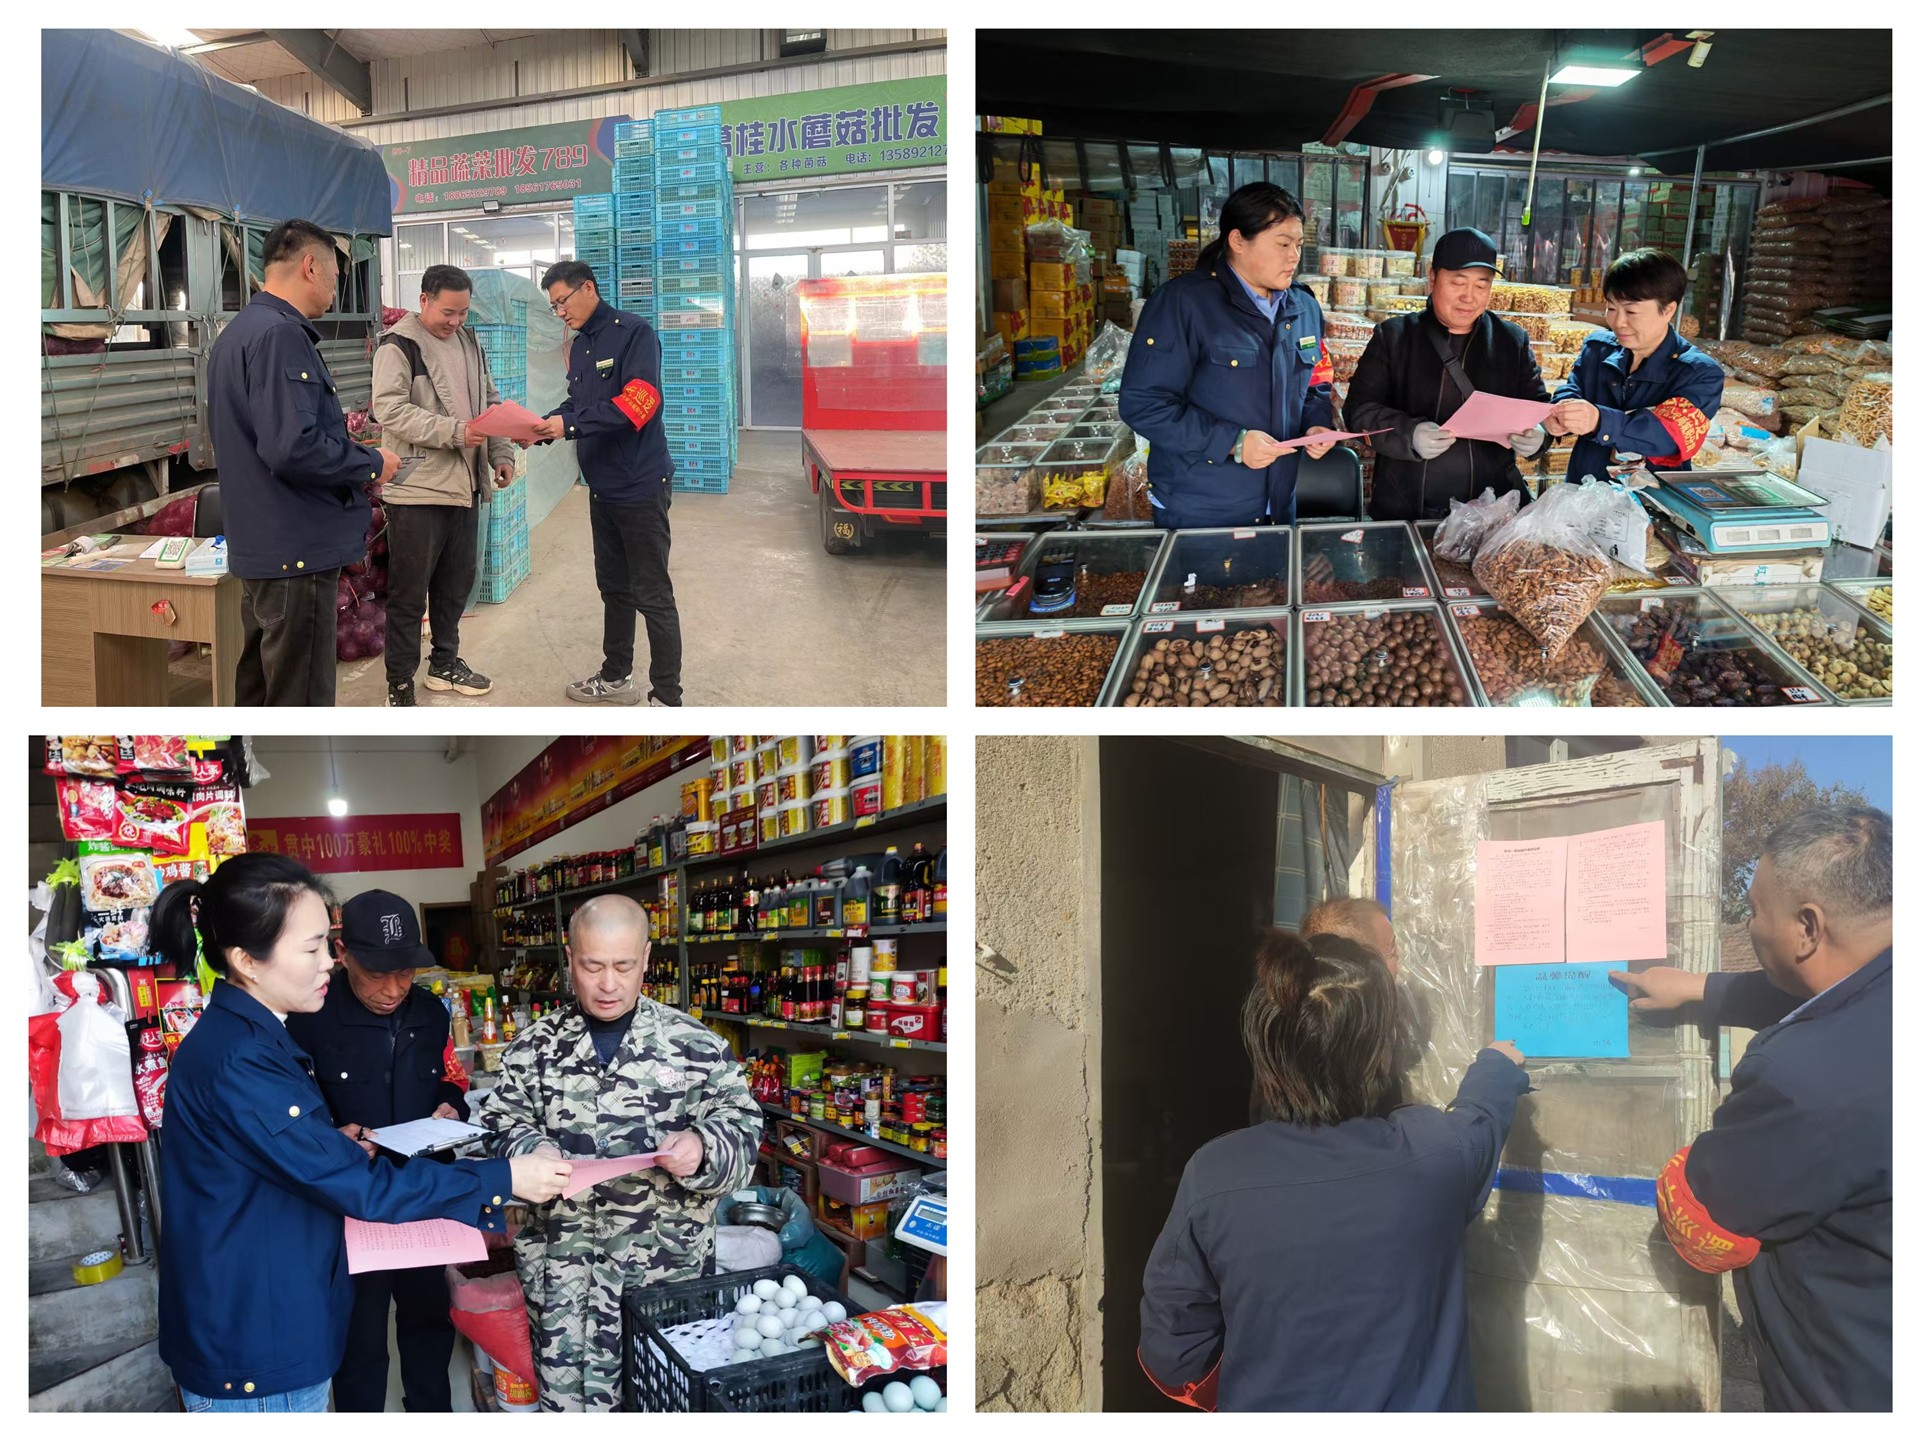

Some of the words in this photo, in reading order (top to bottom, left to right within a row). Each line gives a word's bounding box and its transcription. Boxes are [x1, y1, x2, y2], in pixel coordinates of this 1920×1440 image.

[408, 144, 589, 187] 精品蔬菜批发789
[514, 178, 582, 194] 18561765031
